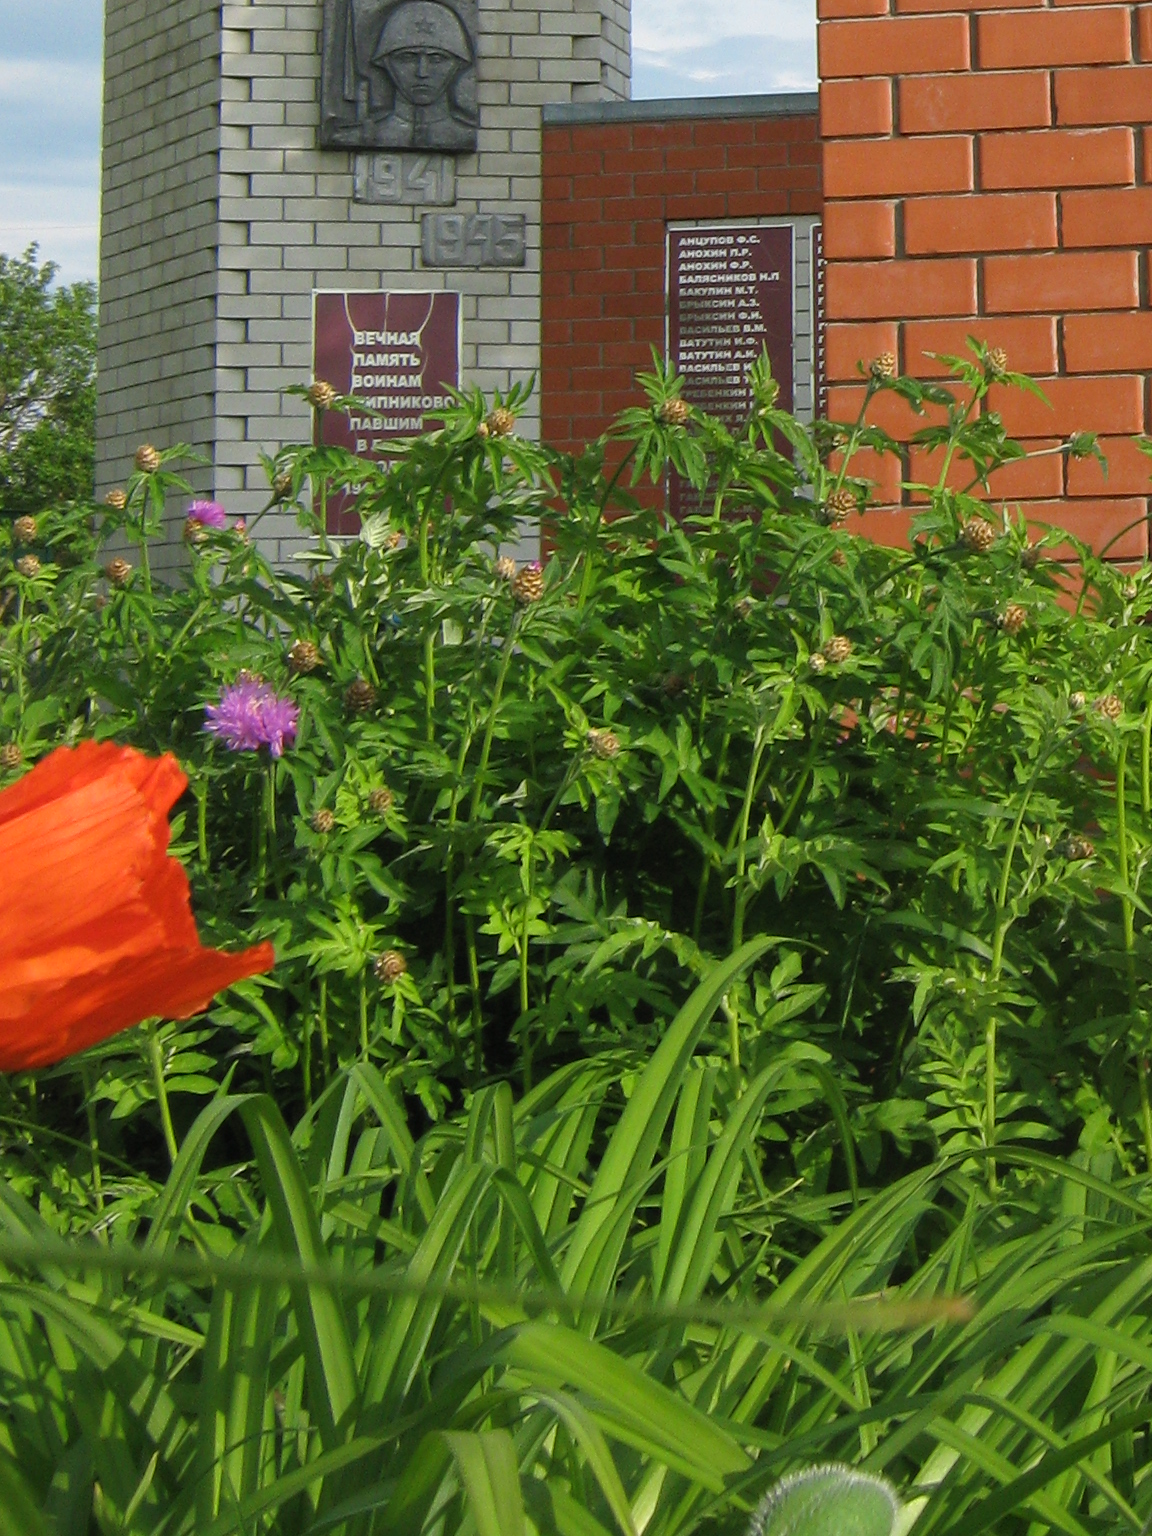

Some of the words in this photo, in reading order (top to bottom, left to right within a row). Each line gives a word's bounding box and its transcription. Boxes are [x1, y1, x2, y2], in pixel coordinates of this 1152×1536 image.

[354, 153, 455, 203] 1941
[422, 214, 524, 263] 1945
[679, 236, 734, 246] АНЦУПОВ
[736, 235, 760, 244] Ф.С.
[678, 249, 727, 259] АНОХИН
[730, 248, 752, 257] П.Р.
[678, 262, 727, 271] АНОХИН
[679, 273, 757, 284] БАЛЯСНИКОВ
[679, 286, 733, 296] БАКУЛИН
[680, 324, 741, 334] ВАСИЛЬЕВ
[354, 332, 421, 345] ВЕЧНАЯ
[679, 338, 731, 348] ВАТУТИН
[353, 353, 421, 367] ПАМЯТЬ
[679, 351, 732, 360] ВАТУТИН
[679, 363, 741, 373] ВАСИЛЬЕВ
[353, 374, 422, 388] ВОИНАМ
[682, 375, 741, 385] АСИЛЬЕВ
[350, 417, 423, 431] ПАВШИМ
